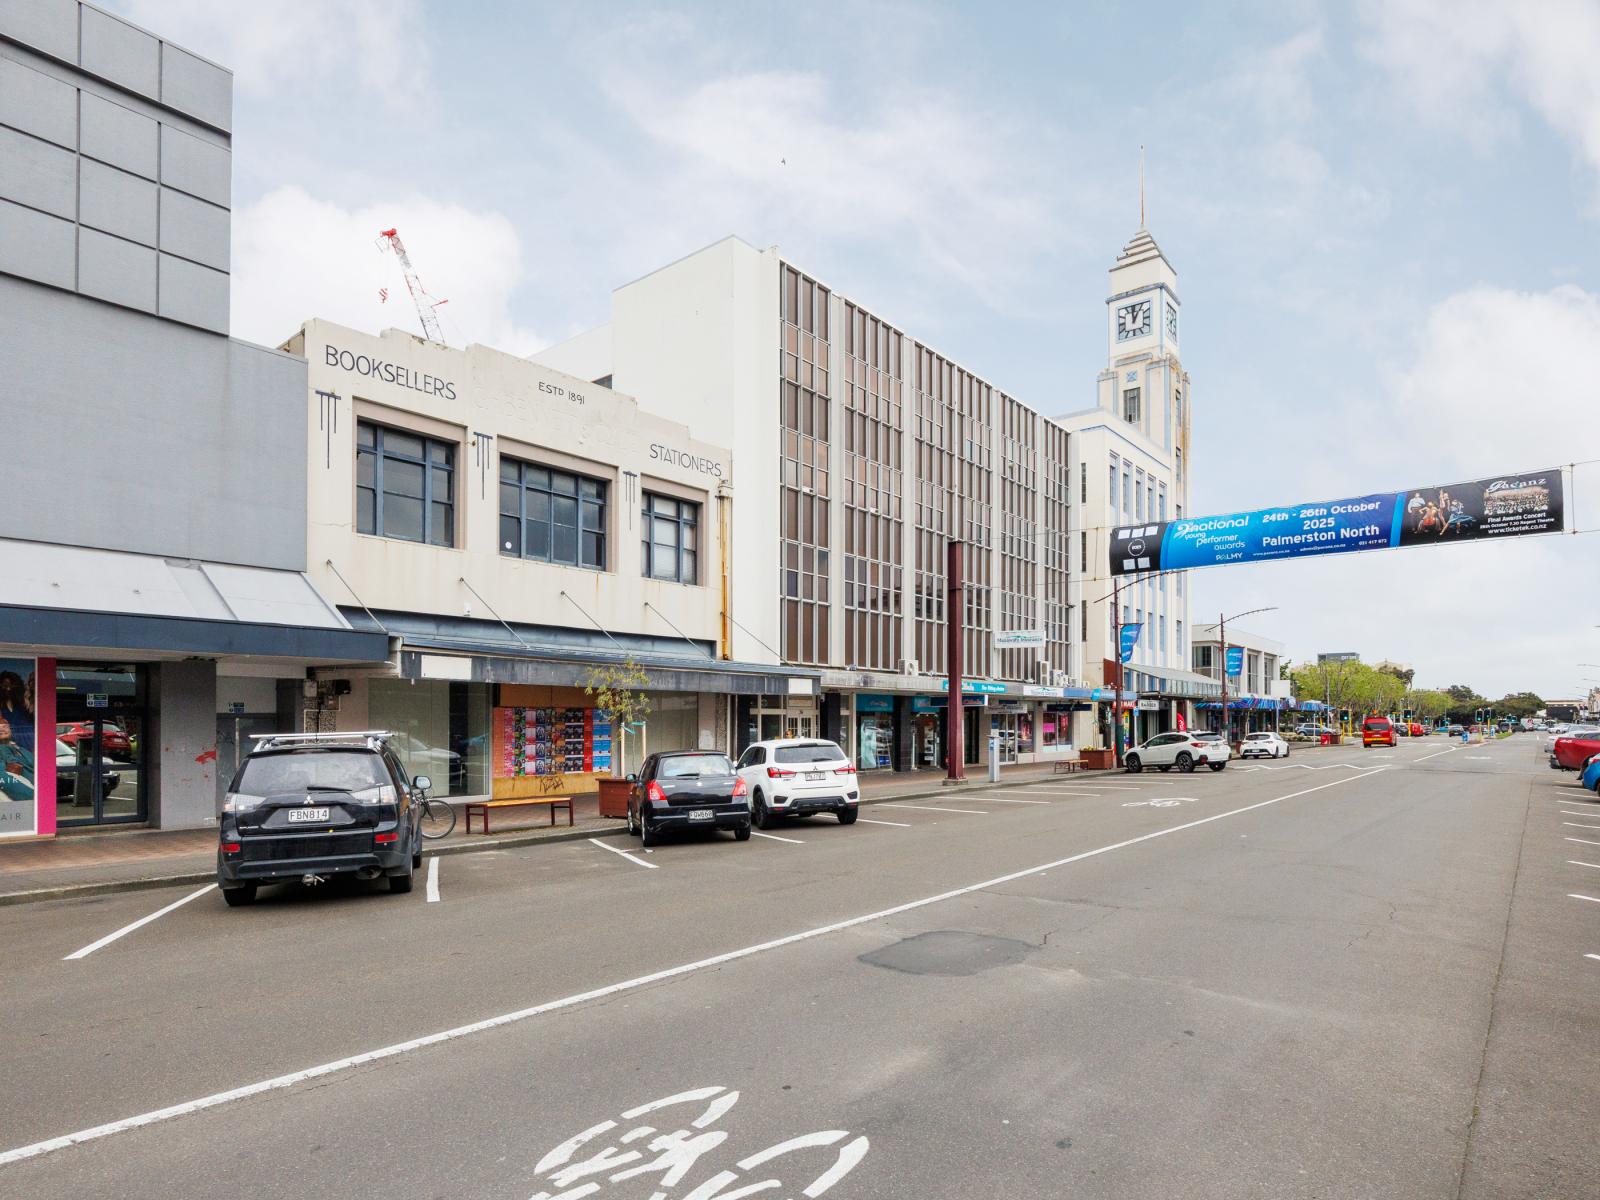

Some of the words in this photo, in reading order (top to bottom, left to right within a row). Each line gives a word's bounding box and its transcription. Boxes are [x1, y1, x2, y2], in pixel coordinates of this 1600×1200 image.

[325, 344, 457, 401] BOOKSELLERS
[538, 381, 564, 396] ESTD
[568, 391, 586, 405] 1891
[649, 443, 722, 477] STATIONERS
[1262, 513, 1288, 523] 24th
[1331, 502, 1381, 514] October
[1523, 512, 1546, 520] Concert
[1190, 515, 1249, 532] national
[1303, 517, 1335, 530] 2025
[1185, 532, 1206, 541] young
[1196, 534, 1239, 548] performer
[1262, 531, 1336, 547] Palmerston
[1340, 525, 1380, 538] North
[1214, 541, 1246, 550] awards
[289, 810, 329, 822] FBN814
